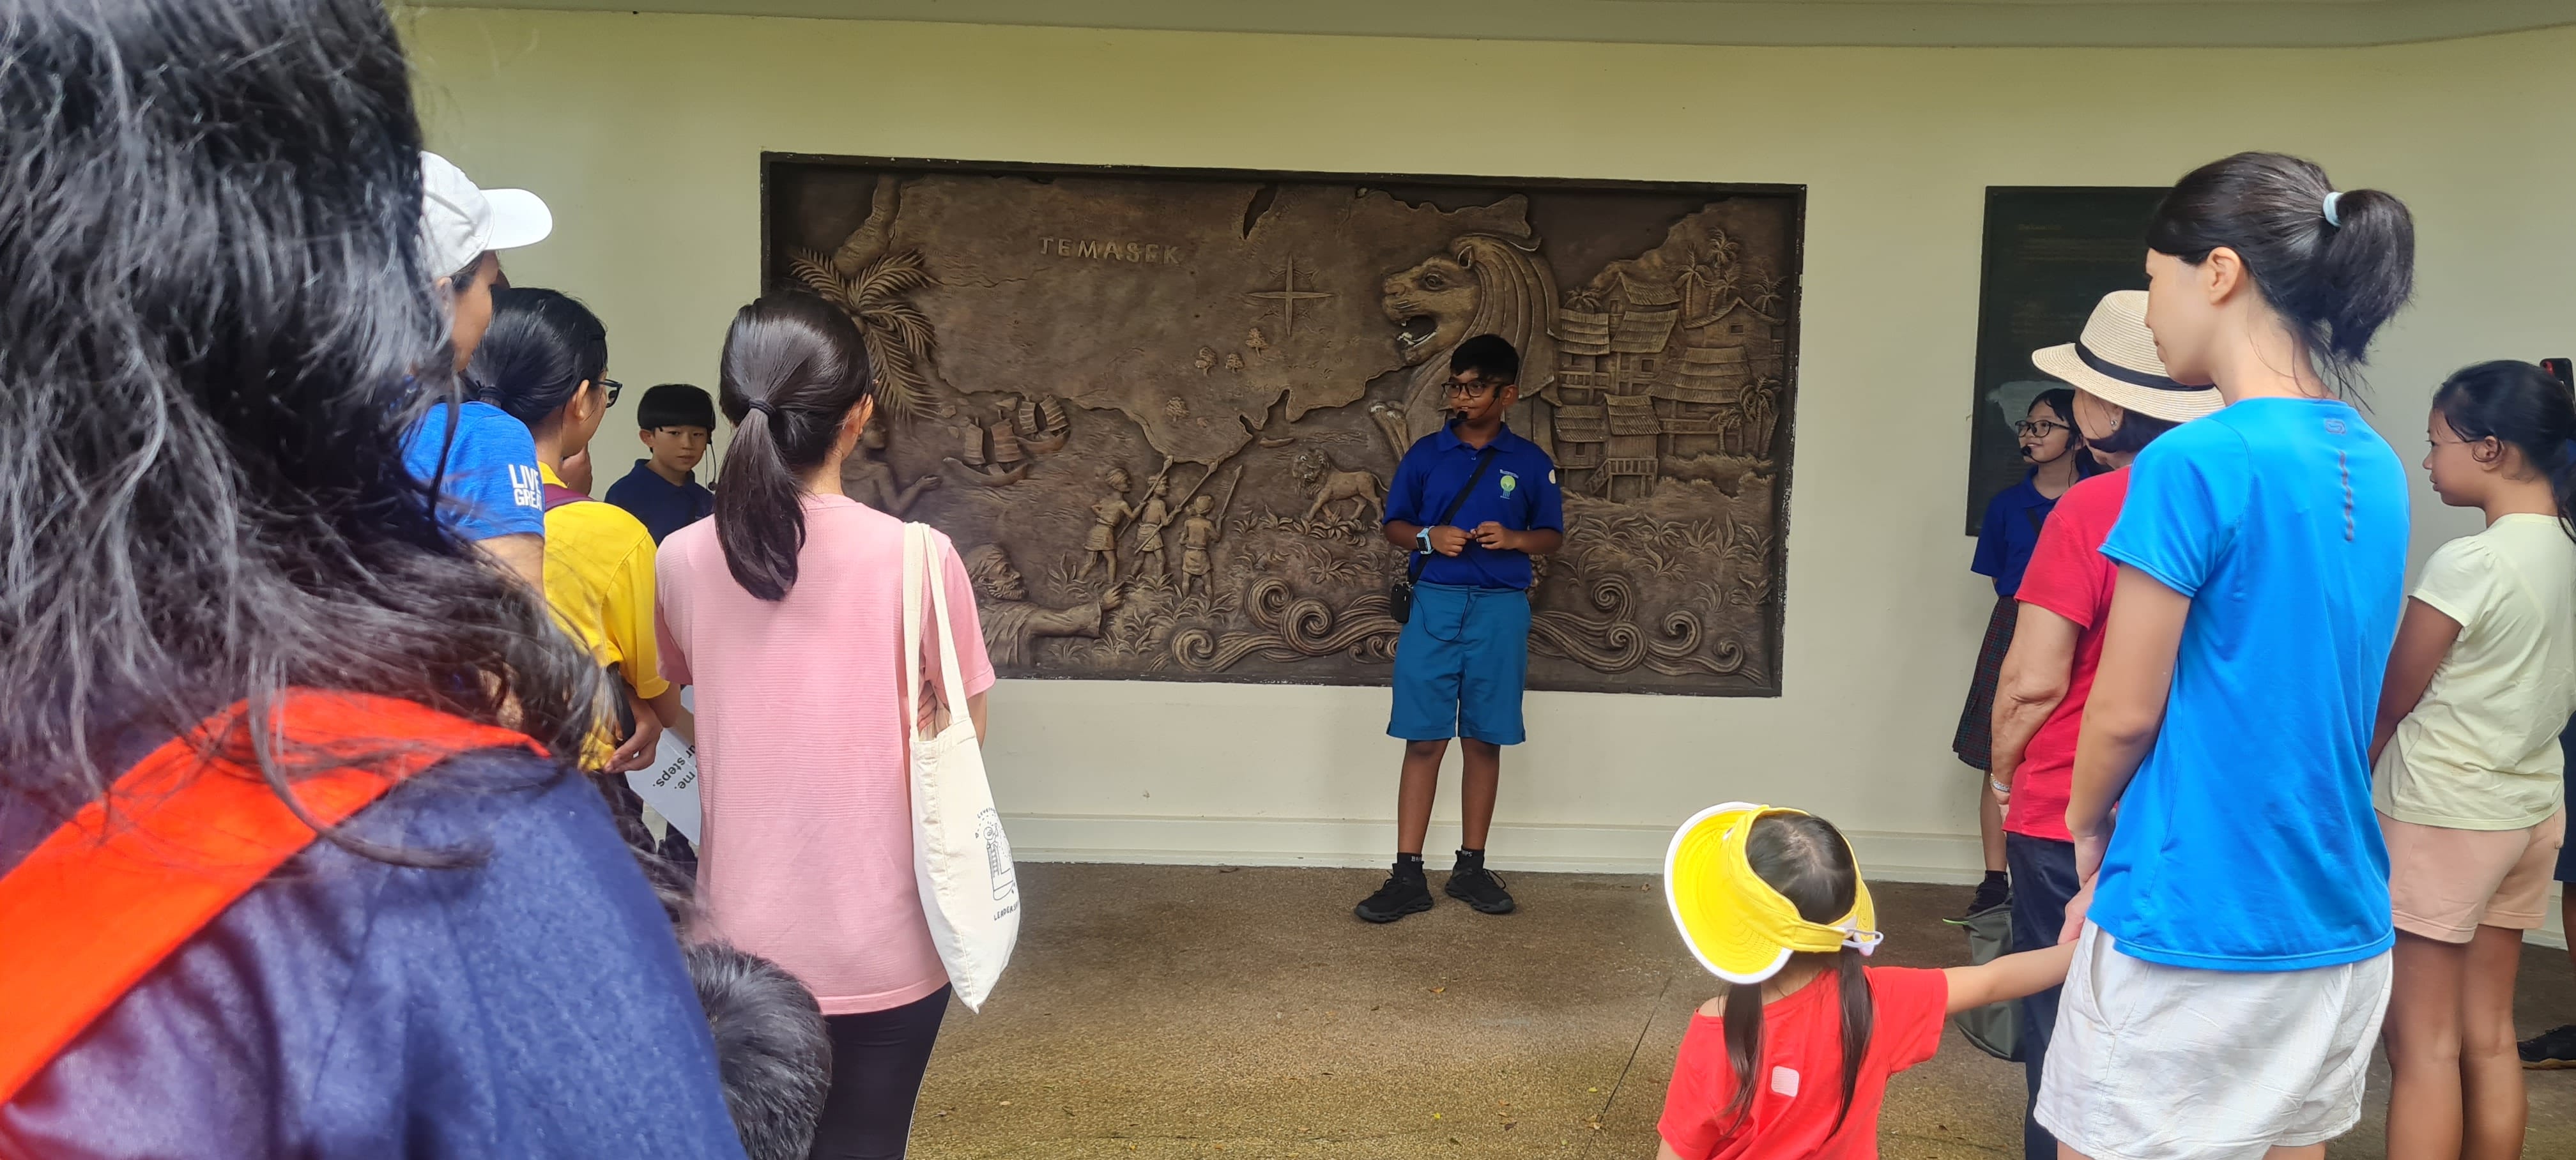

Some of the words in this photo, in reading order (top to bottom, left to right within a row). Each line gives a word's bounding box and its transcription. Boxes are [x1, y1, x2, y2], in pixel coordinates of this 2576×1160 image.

[1038, 236, 1181, 266] TEMASEK
[509, 464, 540, 493] LIVE
[686, 744, 696, 759] ur
[652, 758, 686, 788] steps.
[674, 771, 696, 790] me.
[993, 899, 1020, 921] LEADERS
